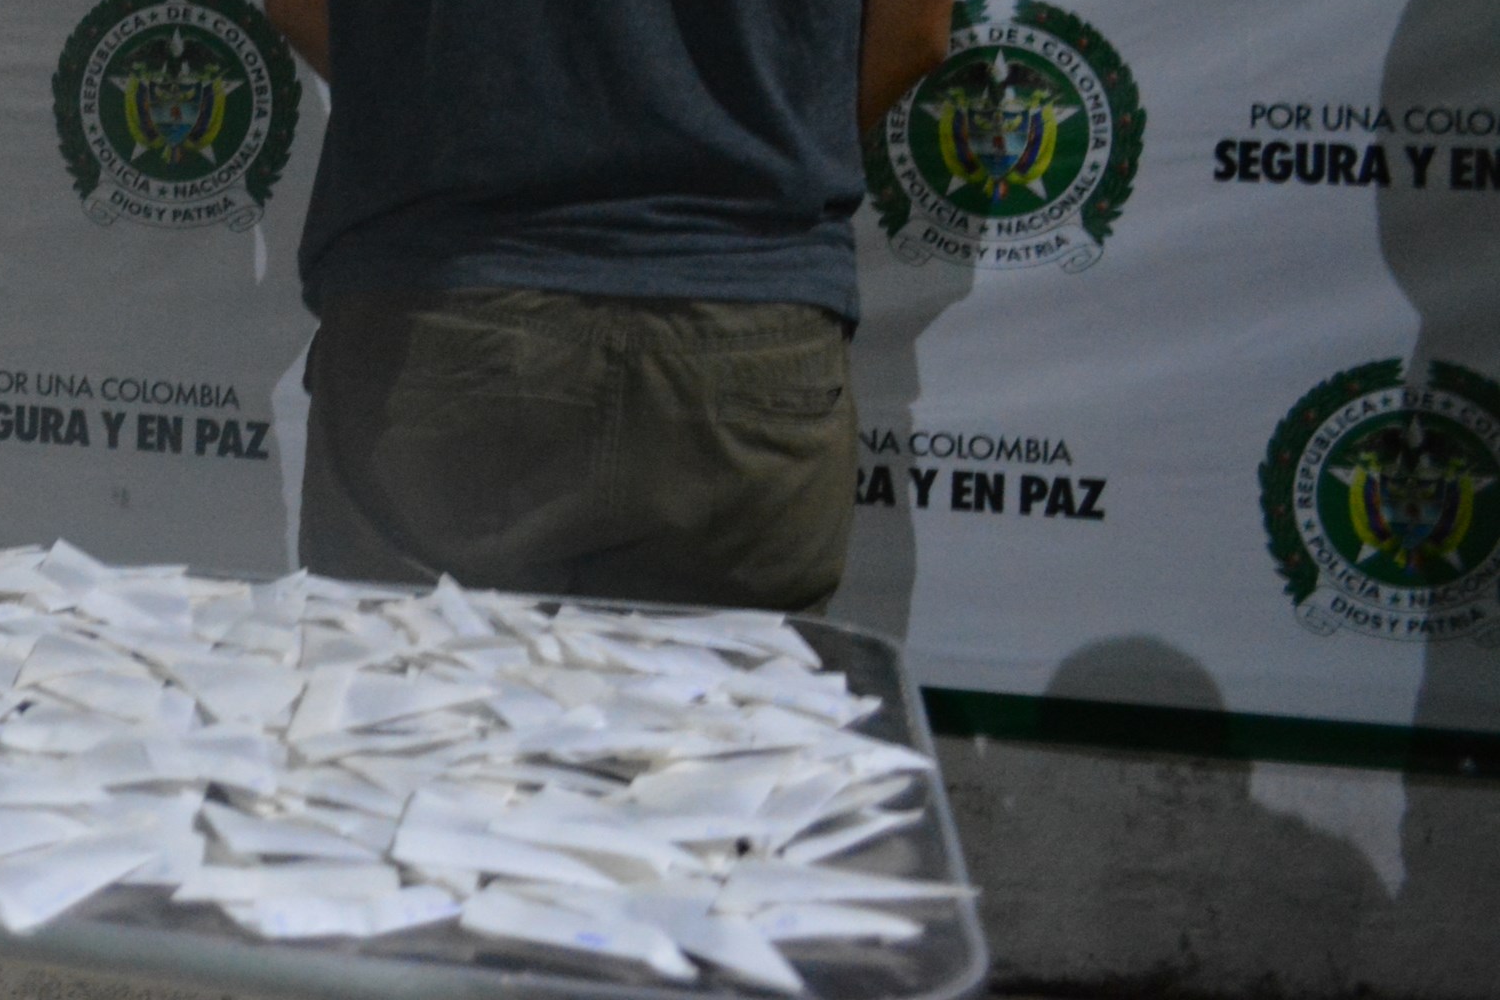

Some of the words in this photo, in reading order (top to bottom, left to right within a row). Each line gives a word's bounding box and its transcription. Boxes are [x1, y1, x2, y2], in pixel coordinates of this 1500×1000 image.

[167, 5, 193, 21] DE
[212, 19, 269, 120] COLOMBIA
[1249, 102, 1314, 132] POR
[1321, 103, 1398, 135] UNA
[1402, 105, 1500, 137] COLO
[172, 142, 259, 199] NACIONAL
[1213, 139, 1392, 189] SEGURA
[1404, 144, 1437, 190] Y
[111, 191, 152, 219] DIOS
[154, 207, 164, 221] Y
[171, 195, 236, 222] PATRIA
[35, 372, 94, 399] UNA
[99, 376, 241, 411] COLOMBIA
[102, 411, 126, 449] Y
[137, 414, 183, 453] EN
[195, 418, 270, 460] PAZ
[907, 431, 1074, 466] COLOMBIA
[908, 467, 939, 509] Y
[951, 470, 1005, 514] EN
[1019, 474, 1107, 521] PAZ
